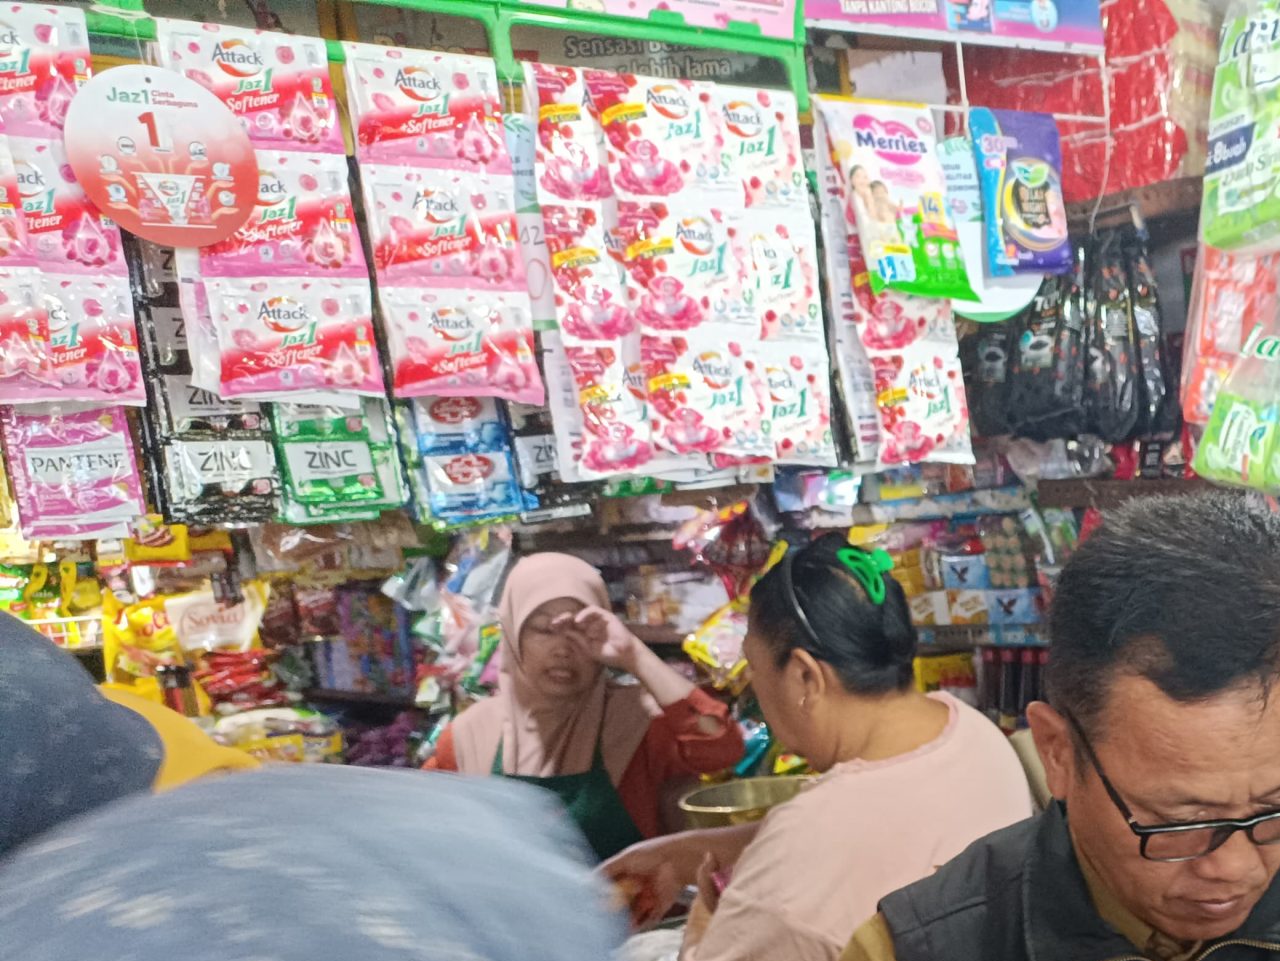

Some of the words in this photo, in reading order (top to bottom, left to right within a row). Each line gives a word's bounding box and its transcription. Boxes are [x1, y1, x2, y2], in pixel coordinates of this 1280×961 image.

[212, 43, 263, 65] Attack
[565, 36, 644, 57] Sensasi
[0, 48, 30, 73] az1
[686, 57, 731, 76] lama
[235, 68, 273, 93] Jaz1
[394, 68, 440, 91] Attack
[106, 87, 150, 105] Jaz1
[414, 92, 451, 118] Jaz1
[855, 131, 928, 154] Merries
[17, 170, 45, 187] ack
[260, 180, 288, 194] ack
[24, 187, 56, 214] az1
[262, 195, 297, 222] Jaz1
[27, 215, 62, 230] tener
[257, 301, 309, 320] Attack
[51, 322, 80, 348] az1
[279, 321, 318, 348] Jaz1
[53, 347, 87, 365] tener
[30, 452, 126, 474] PANTENE
[304, 449, 357, 470] ZINC
